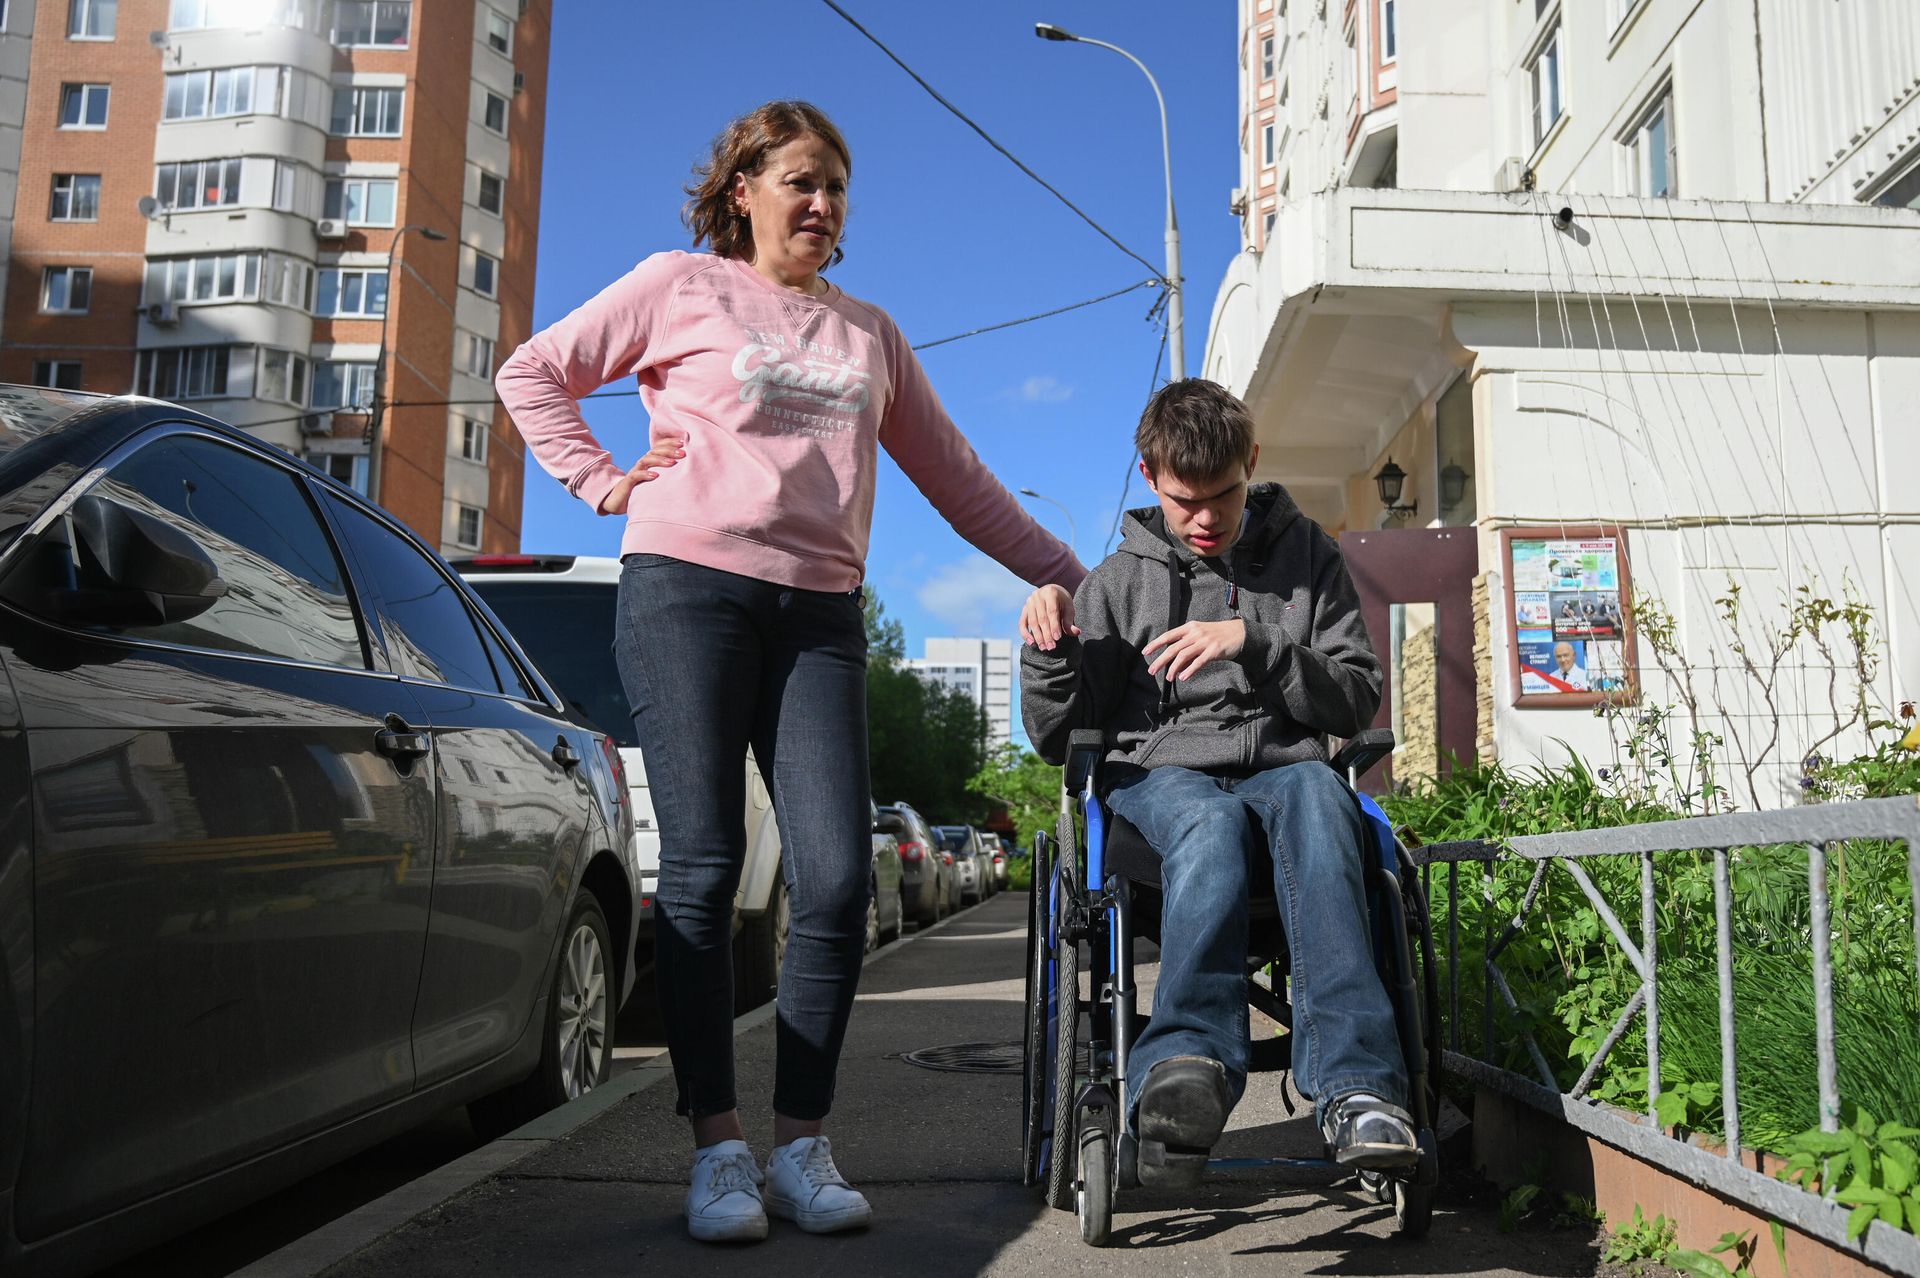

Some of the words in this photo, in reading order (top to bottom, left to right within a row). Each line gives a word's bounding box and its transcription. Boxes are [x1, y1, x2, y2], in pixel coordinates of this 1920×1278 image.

[744, 329, 785, 346] NEW
[795, 335, 861, 367] HAVEN
[731, 343, 872, 414] Gant
[755, 402, 856, 432] CONNECTICUT
[771, 420, 797, 433] EAST
